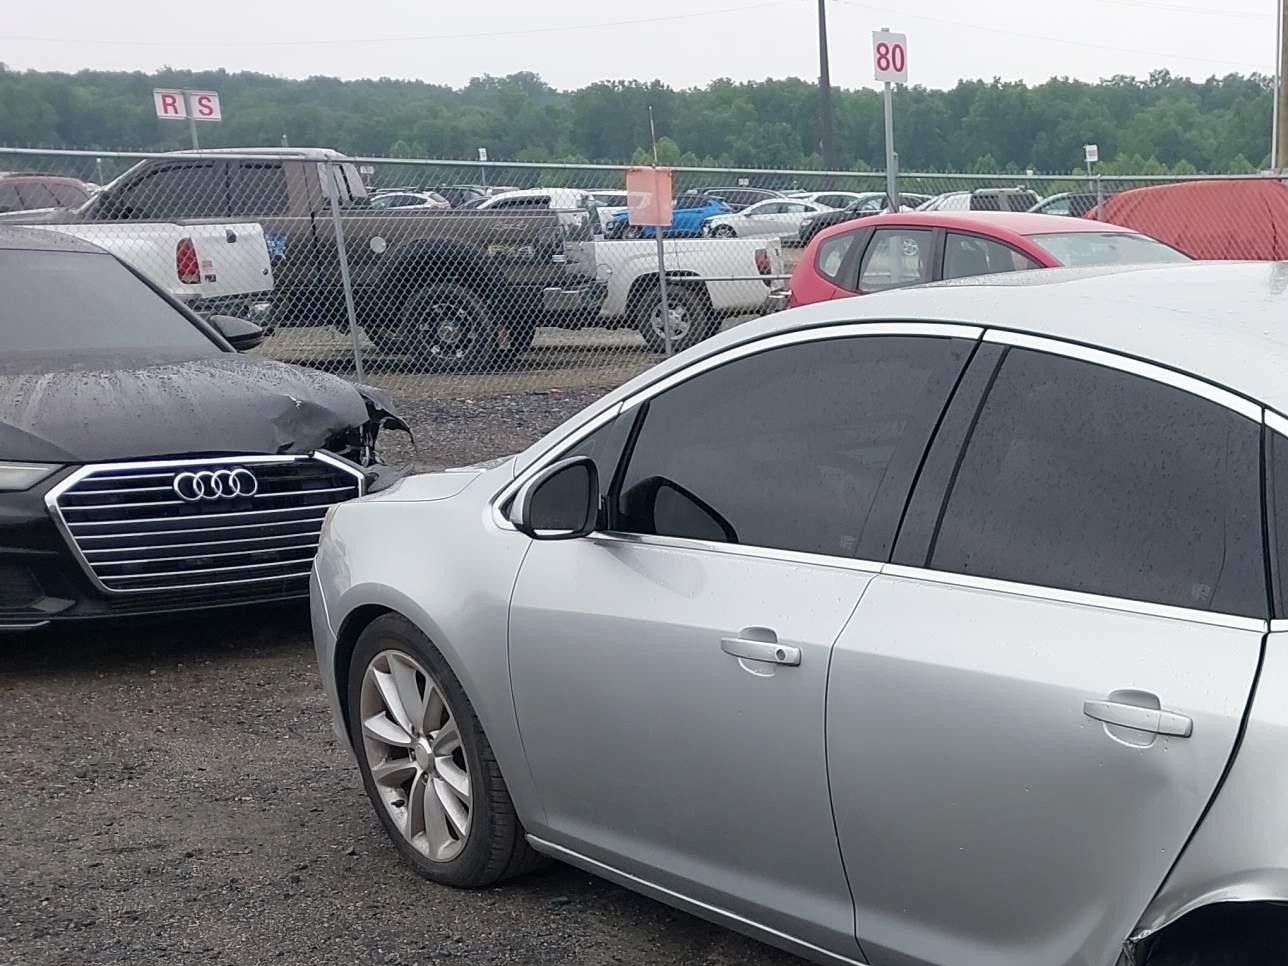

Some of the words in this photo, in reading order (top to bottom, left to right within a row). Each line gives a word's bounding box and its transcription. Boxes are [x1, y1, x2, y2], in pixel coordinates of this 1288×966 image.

[876, 42, 905, 72] 80
[161, 94, 179, 115] R
[198, 96, 213, 116] S
